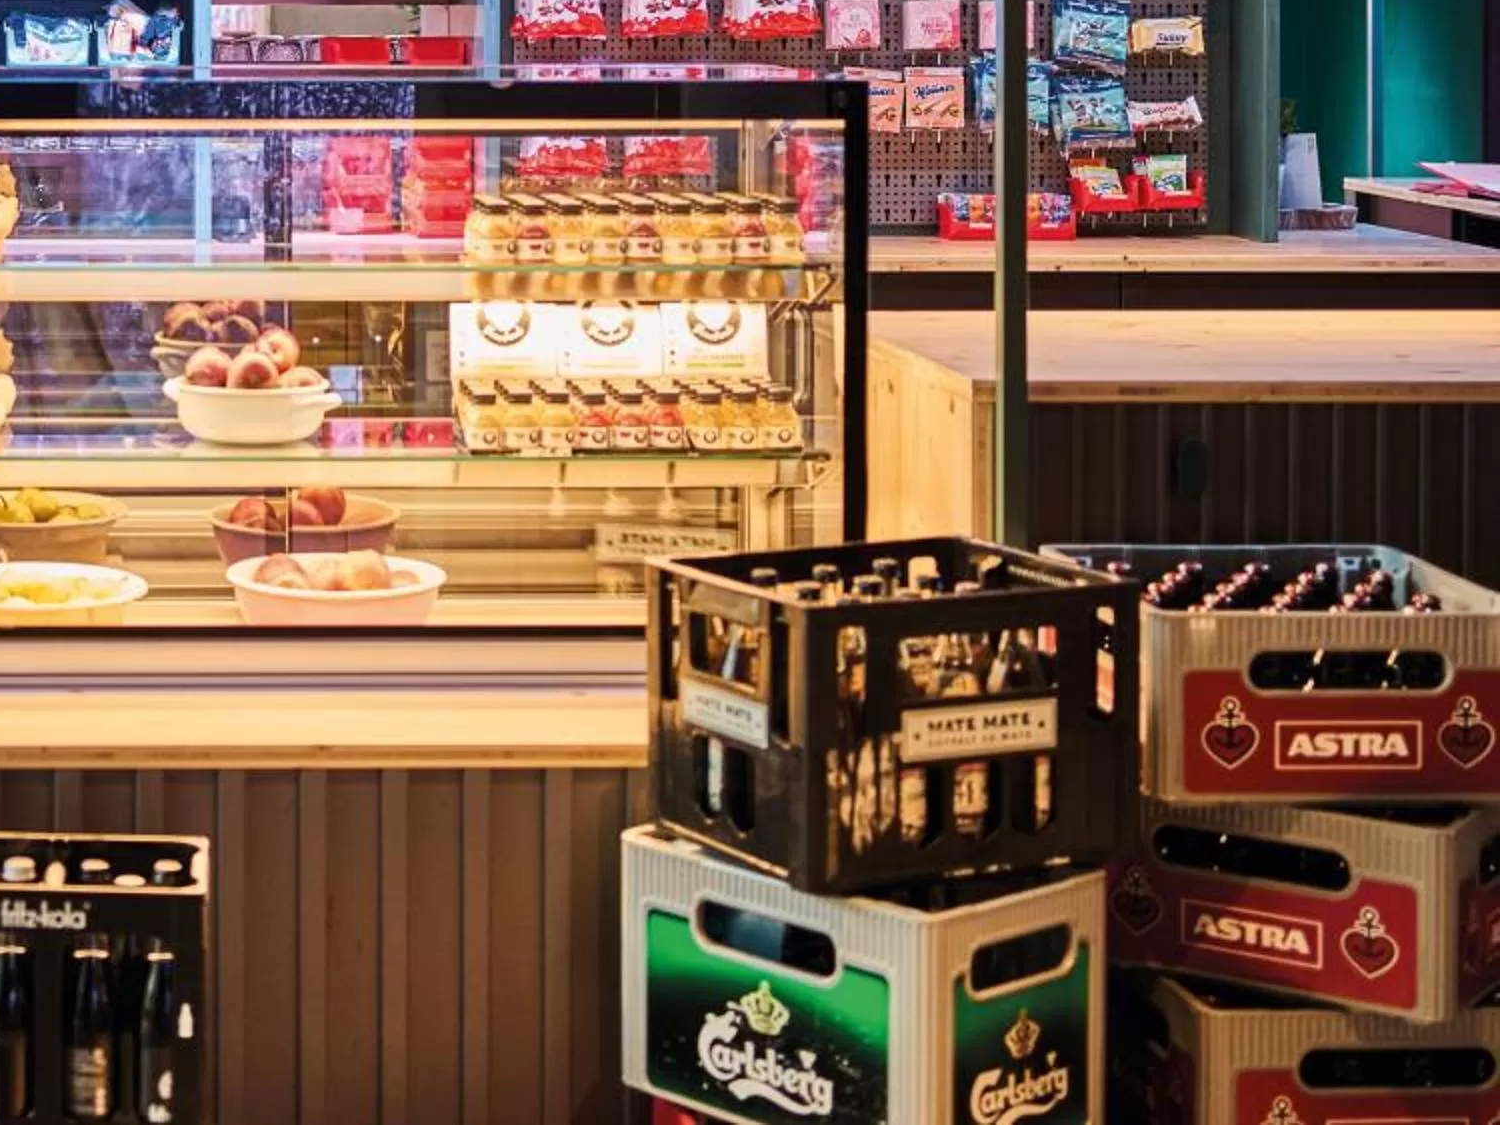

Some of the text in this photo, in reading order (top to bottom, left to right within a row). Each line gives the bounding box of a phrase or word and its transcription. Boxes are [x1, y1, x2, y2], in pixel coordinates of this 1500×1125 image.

[926, 711, 1031, 732] MATE MATE
[1287, 732, 1410, 758] ASTRA
[0, 898, 87, 929] fritz-kola
[1193, 914, 1311, 955] ASTRA
[697, 1007, 834, 1115] Carlsberg
[969, 1063, 1069, 1125] Carlsberg
